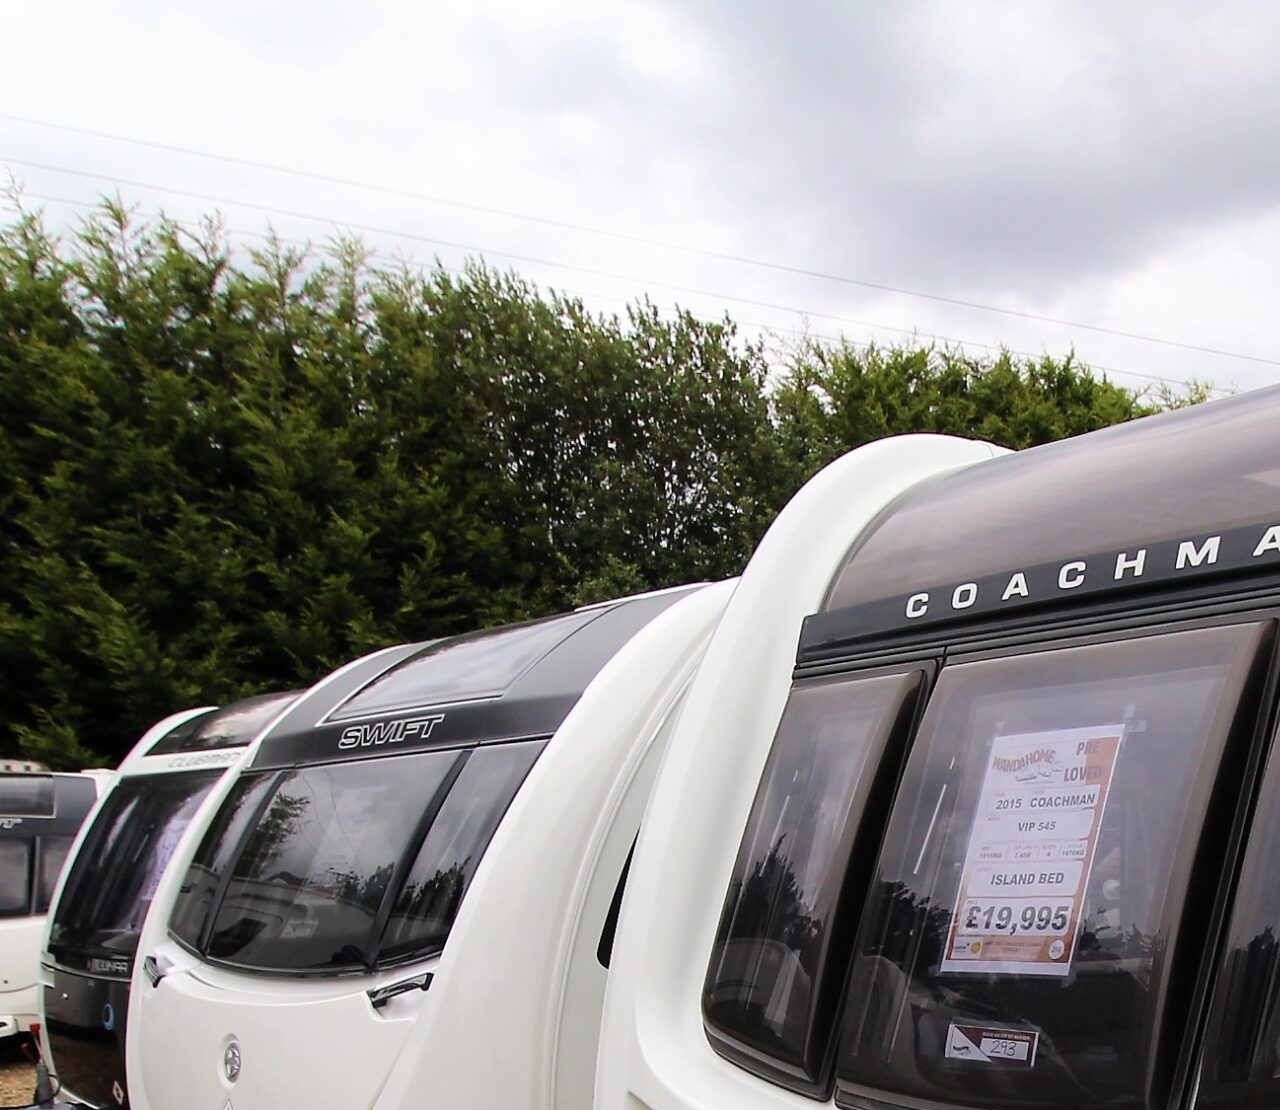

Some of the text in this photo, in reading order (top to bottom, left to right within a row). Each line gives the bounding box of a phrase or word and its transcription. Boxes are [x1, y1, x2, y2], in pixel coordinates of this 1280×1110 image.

[338, 714, 446, 750] SWIFT
[992, 748, 1057, 773] WANDAHOME
[995, 793, 1096, 810] 2015 COACHMAN
[1017, 821, 1057, 832] VIP 545
[990, 872, 1065, 886] ISLAND BED
[965, 905, 1070, 936] £19,995
[990, 1040, 1017, 1057] 293
